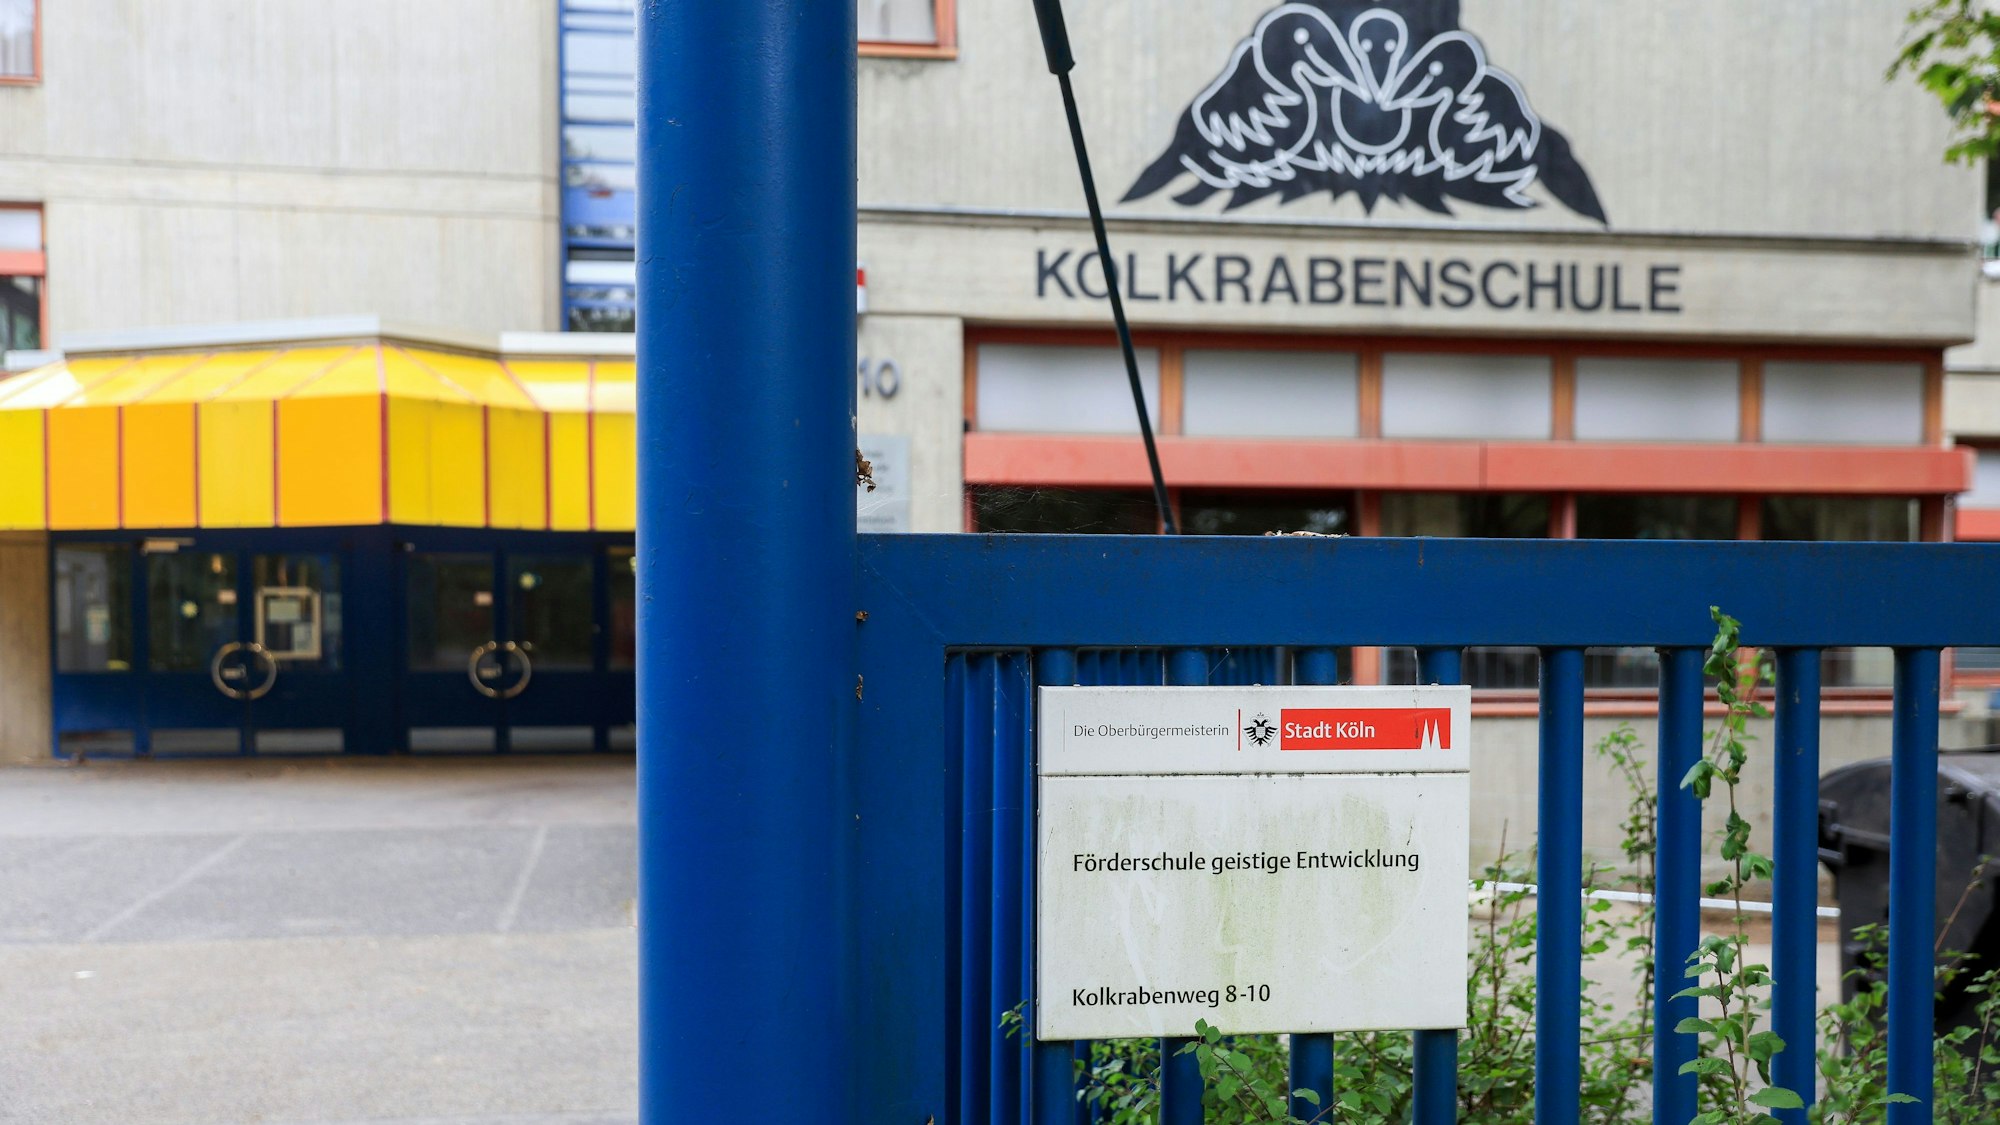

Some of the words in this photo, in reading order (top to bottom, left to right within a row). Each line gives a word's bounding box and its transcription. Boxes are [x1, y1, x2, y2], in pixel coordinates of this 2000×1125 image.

[1036, 248, 1683, 314] KOLKRABENSCHULE
[1074, 724, 1095, 737] Die
[1097, 723, 1229, 740] Oberbürgermeisterin
[1285, 721, 1332, 739] Stadt
[1337, 721, 1375, 738] Köln
[1073, 851, 1206, 873] Förderschule
[1211, 851, 1291, 875] geistige
[1297, 849, 1420, 872] Entwicklung
[1072, 985, 1220, 1008] Kolkrabenweg
